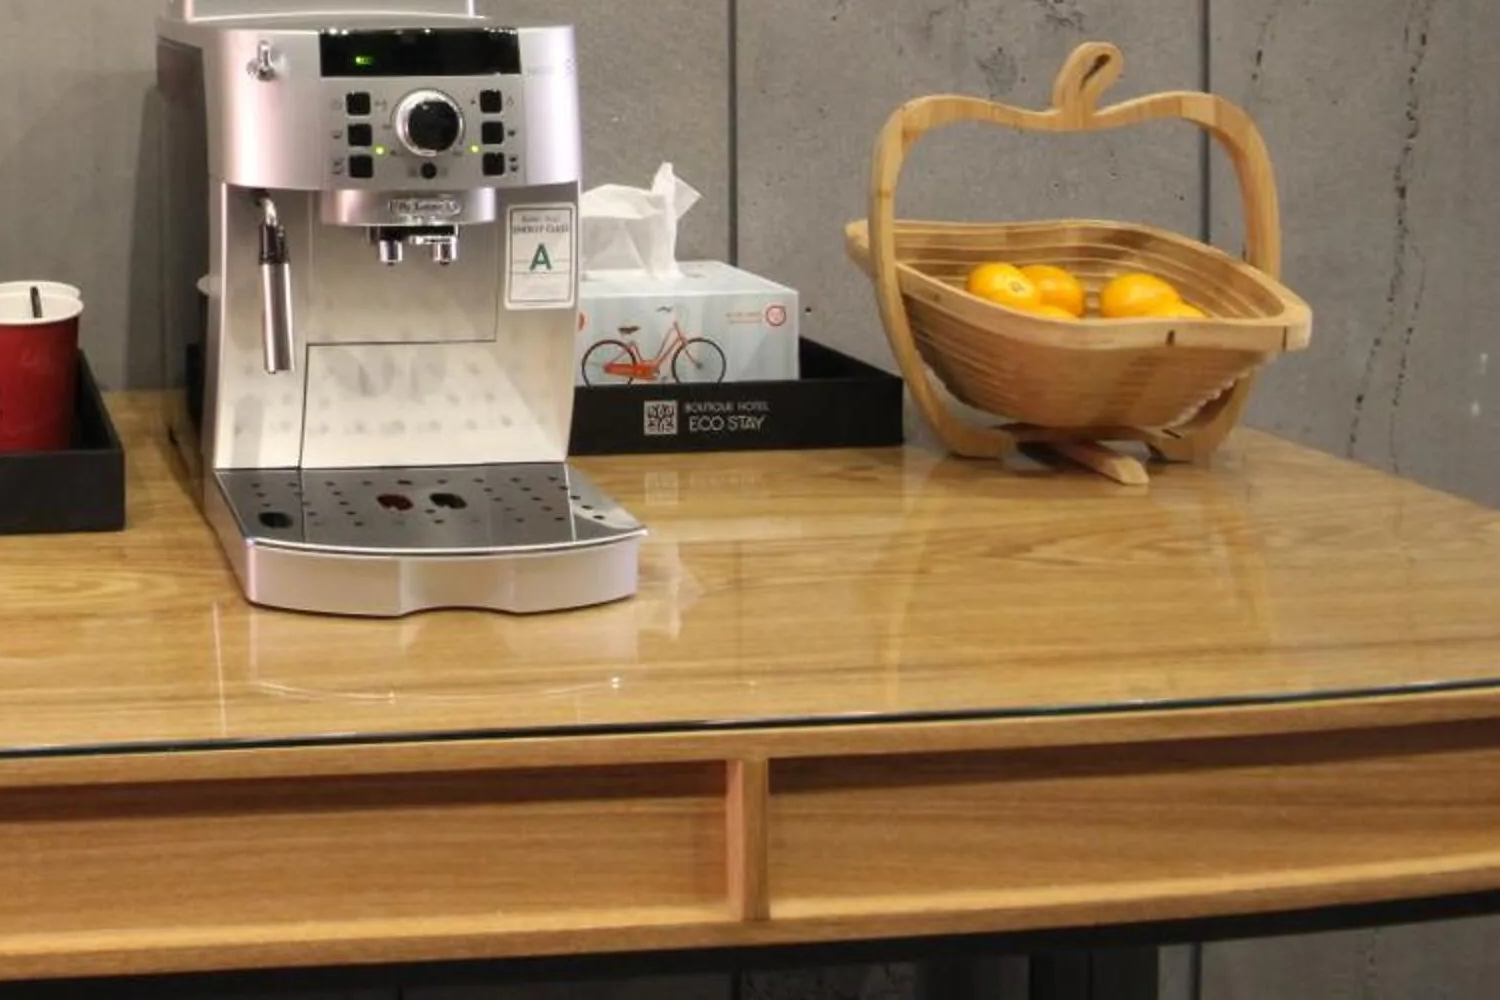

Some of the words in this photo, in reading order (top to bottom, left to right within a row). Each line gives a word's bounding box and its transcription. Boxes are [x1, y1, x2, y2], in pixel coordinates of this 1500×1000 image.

[529, 243, 552, 271] A
[689, 415, 724, 432] ECO
[727, 414, 766, 431] STAY
